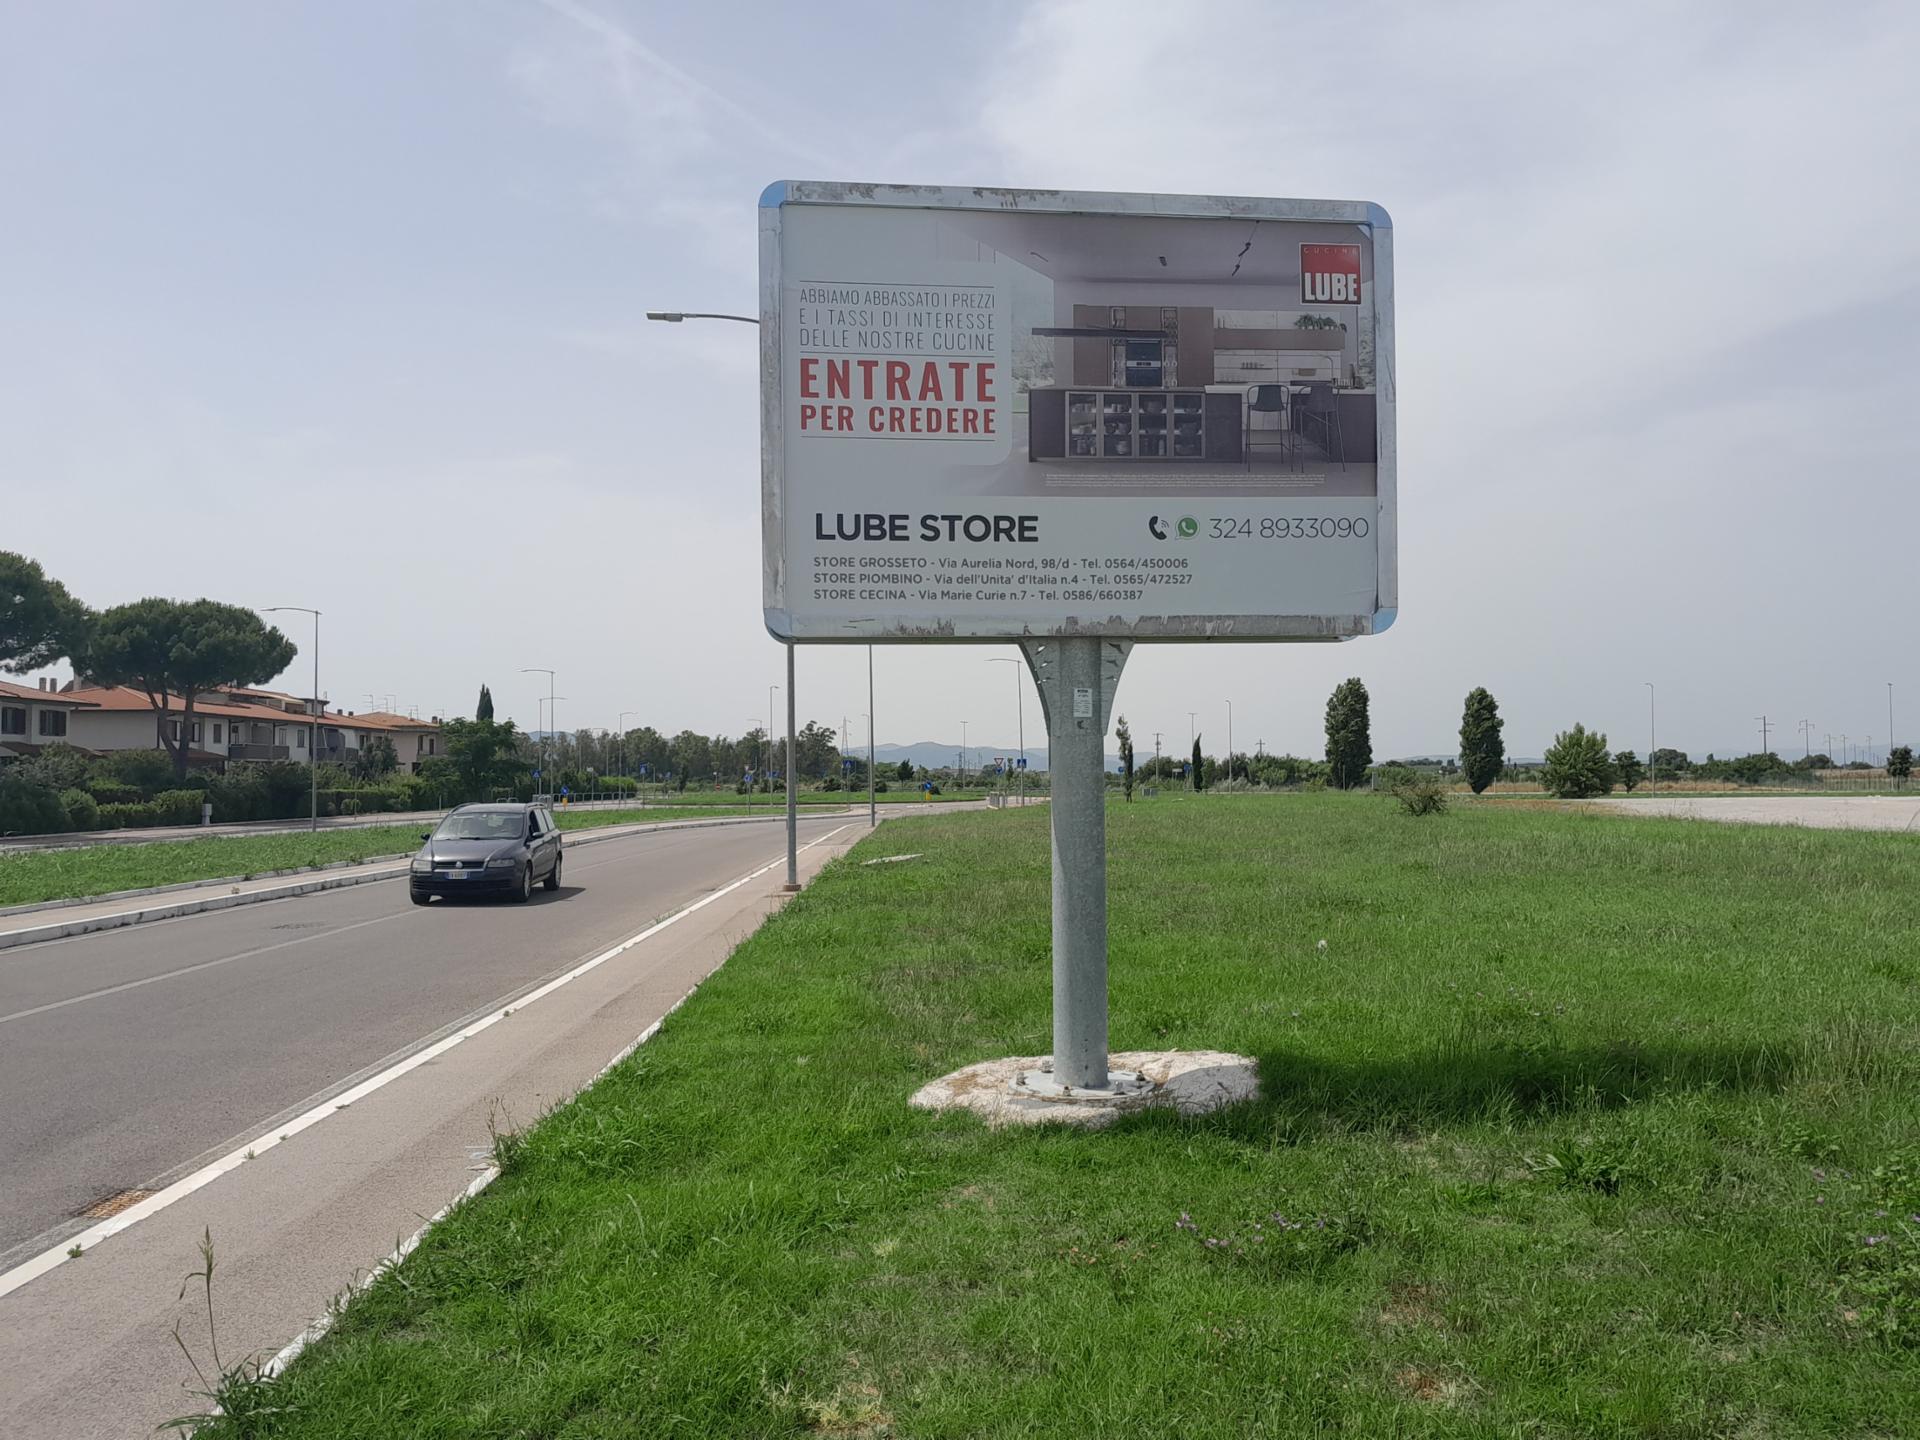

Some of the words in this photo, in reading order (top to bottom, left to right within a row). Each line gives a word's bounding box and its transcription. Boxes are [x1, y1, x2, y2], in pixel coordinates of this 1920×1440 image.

[800, 288, 860, 305] ABBIAMO
[864, 290, 940, 308] ABBASSATO
[943, 292, 948, 308] I
[952, 293, 995, 309] PREZZI
[1304, 272, 1358, 302] LUBE
[799, 307, 807, 325] E
[814, 308, 819, 325] I
[827, 309, 874, 327] TASSI
[883, 310, 899, 328] DI
[907, 311, 995, 330] INTERESSE
[800, 328, 849, 348] DELLE
[858, 330, 924, 350] NOSTRE
[932, 332, 995, 352] CUCINE
[799, 357, 996, 403] ENTRATE
[800, 404, 855, 432] PER
[868, 406, 996, 434] CREDERE
[815, 512, 911, 542] LUBE
[919, 513, 1039, 543] STORE
[1208, 517, 1254, 539] 324
[1259, 517, 1370, 539] 8933090
[813, 556, 856, 568] STORE
[859, 556, 928, 569] GROSSETO
[938, 558, 958, 569] Via
[960, 558, 1002, 569] Aurelia
[1005, 558, 1038, 571] Nord,
[1041, 558, 1070, 570] 98/d
[1080, 558, 1102, 569] Tel.
[1104, 557, 1189, 571] 0564/450006
[813, 572, 856, 584] STORE
[859, 573, 923, 585] PIOMBINO
[933, 574, 953, 585] Via
[1017, 574, 1058, 585] d'Italia
[1060, 574, 1079, 585] n.4
[1089, 574, 1111, 585] Tel.
[1113, 574, 1193, 587] 0565/472527
[813, 589, 856, 600] STORE
[859, 589, 907, 601] CECINA
[917, 590, 938, 601] Via
[940, 590, 973, 601] Marie
[975, 590, 1007, 601] Curie
[1010, 590, 1028, 601] n.7
[1038, 590, 1060, 601] Tel.
[1062, 589, 1144, 602] 0586/660387
